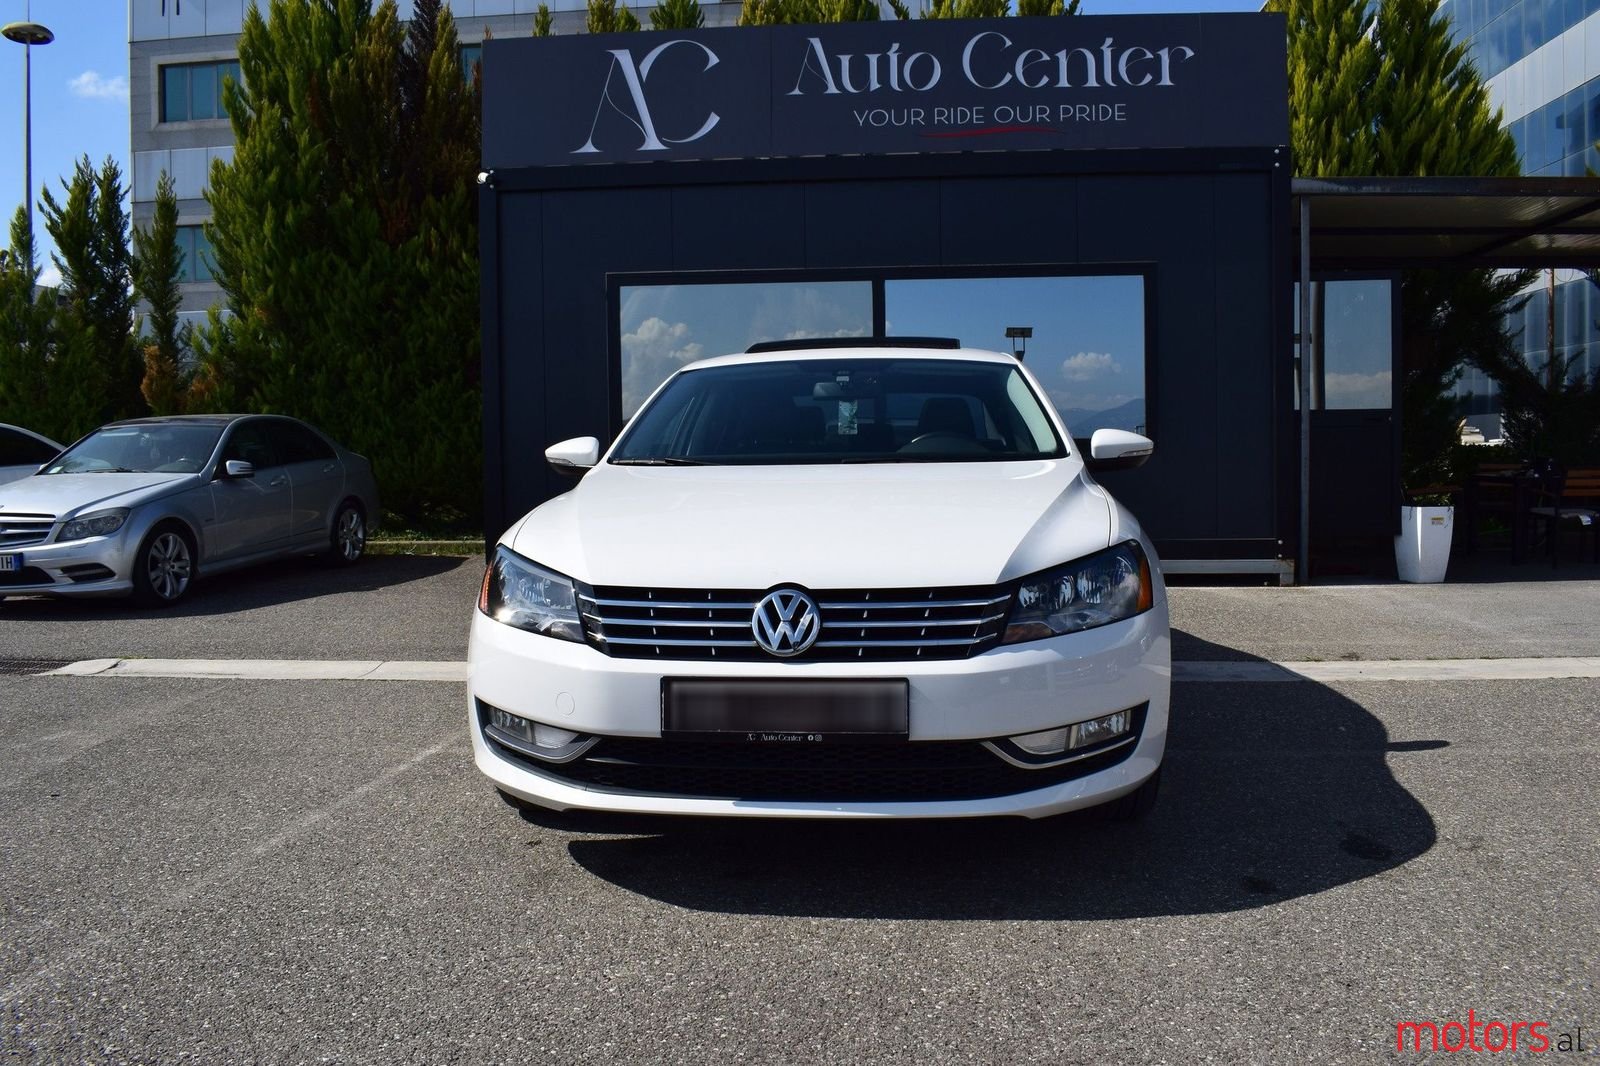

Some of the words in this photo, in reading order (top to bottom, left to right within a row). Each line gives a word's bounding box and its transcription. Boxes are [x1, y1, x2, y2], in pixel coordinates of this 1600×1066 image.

[785, 37, 942, 96] Auto
[962, 31, 1196, 90] Center
[569, 39, 721, 154] AC
[853, 108, 926, 127] YOUR
[934, 106, 985, 125] RIDE
[993, 105, 1051, 124] OUR
[1059, 103, 1127, 122] PRIDE
[761, 733, 778, 742] Auto
[778, 733, 803, 742] Center
